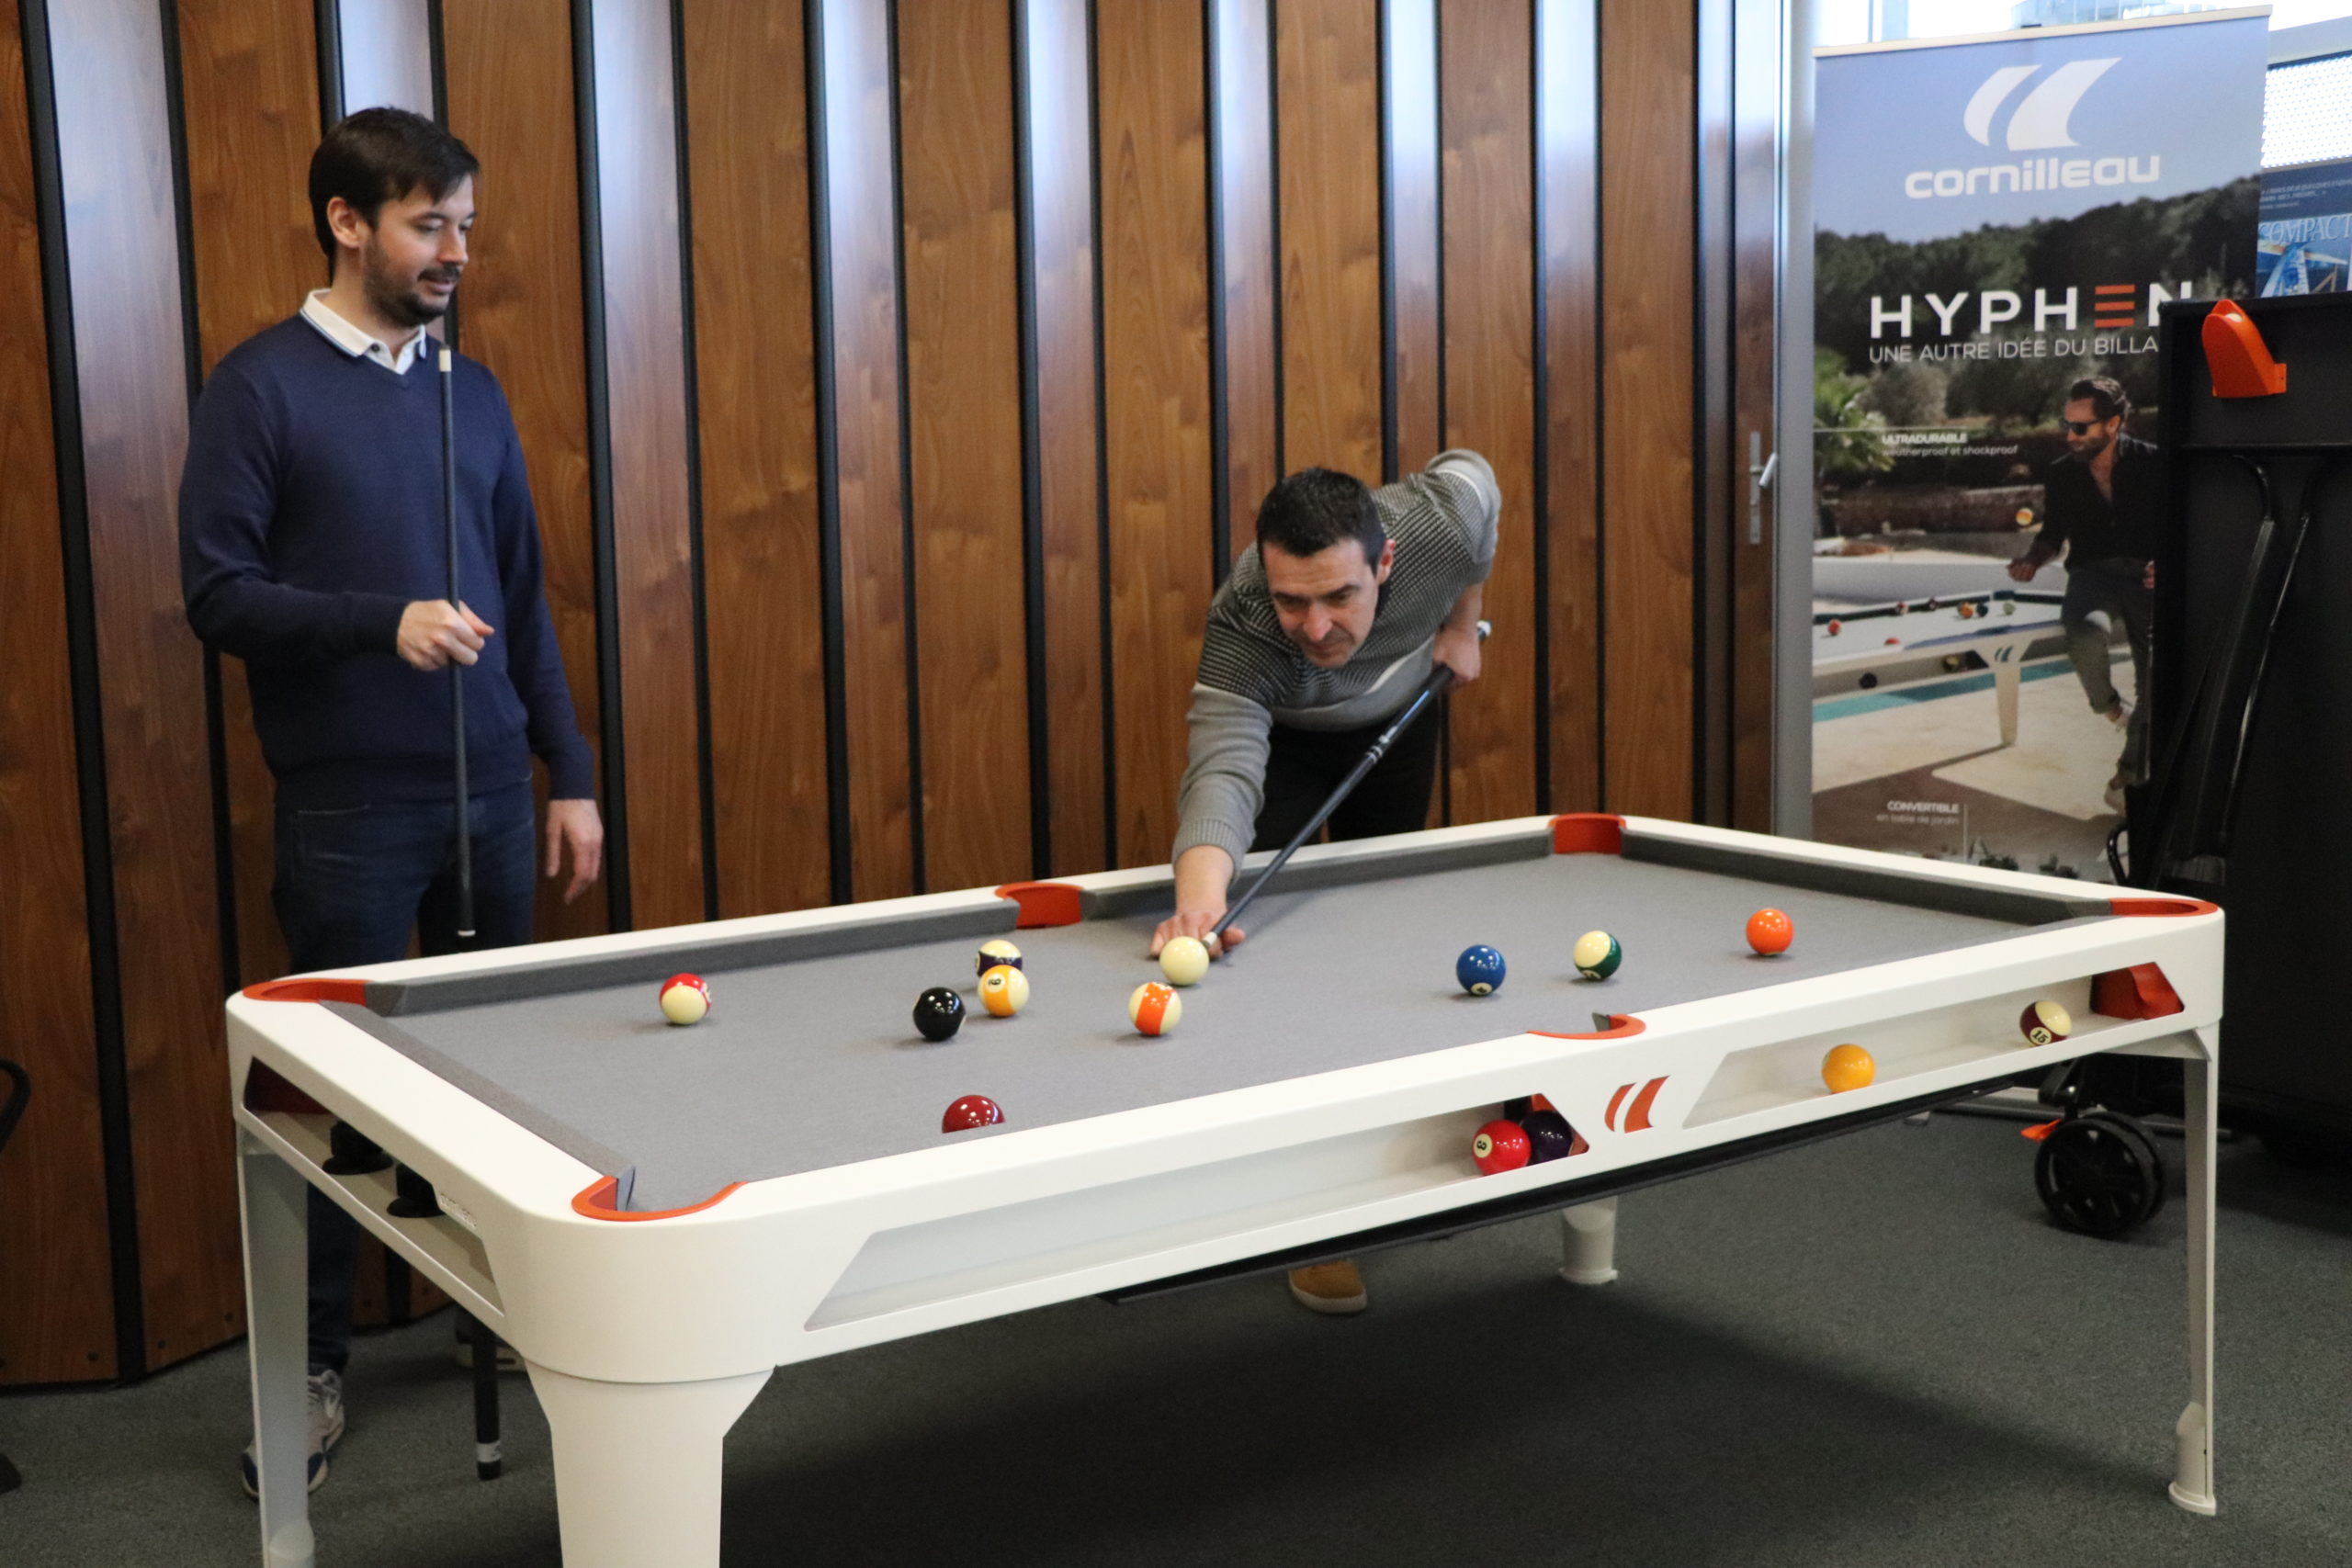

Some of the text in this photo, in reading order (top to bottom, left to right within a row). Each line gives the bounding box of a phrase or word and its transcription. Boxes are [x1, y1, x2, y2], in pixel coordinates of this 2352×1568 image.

[1871, 281, 2192, 339] HYPHEN
[1869, 335, 2159, 364] UNE AUTRE IDÉE DU BILLA
[1882, 432, 1968, 446] ULTRADURABLE
[1950, 446, 1962, 456] et
[1962, 444, 2019, 457] shockproof
[1886, 800, 1960, 815] CONVERTIBLE
